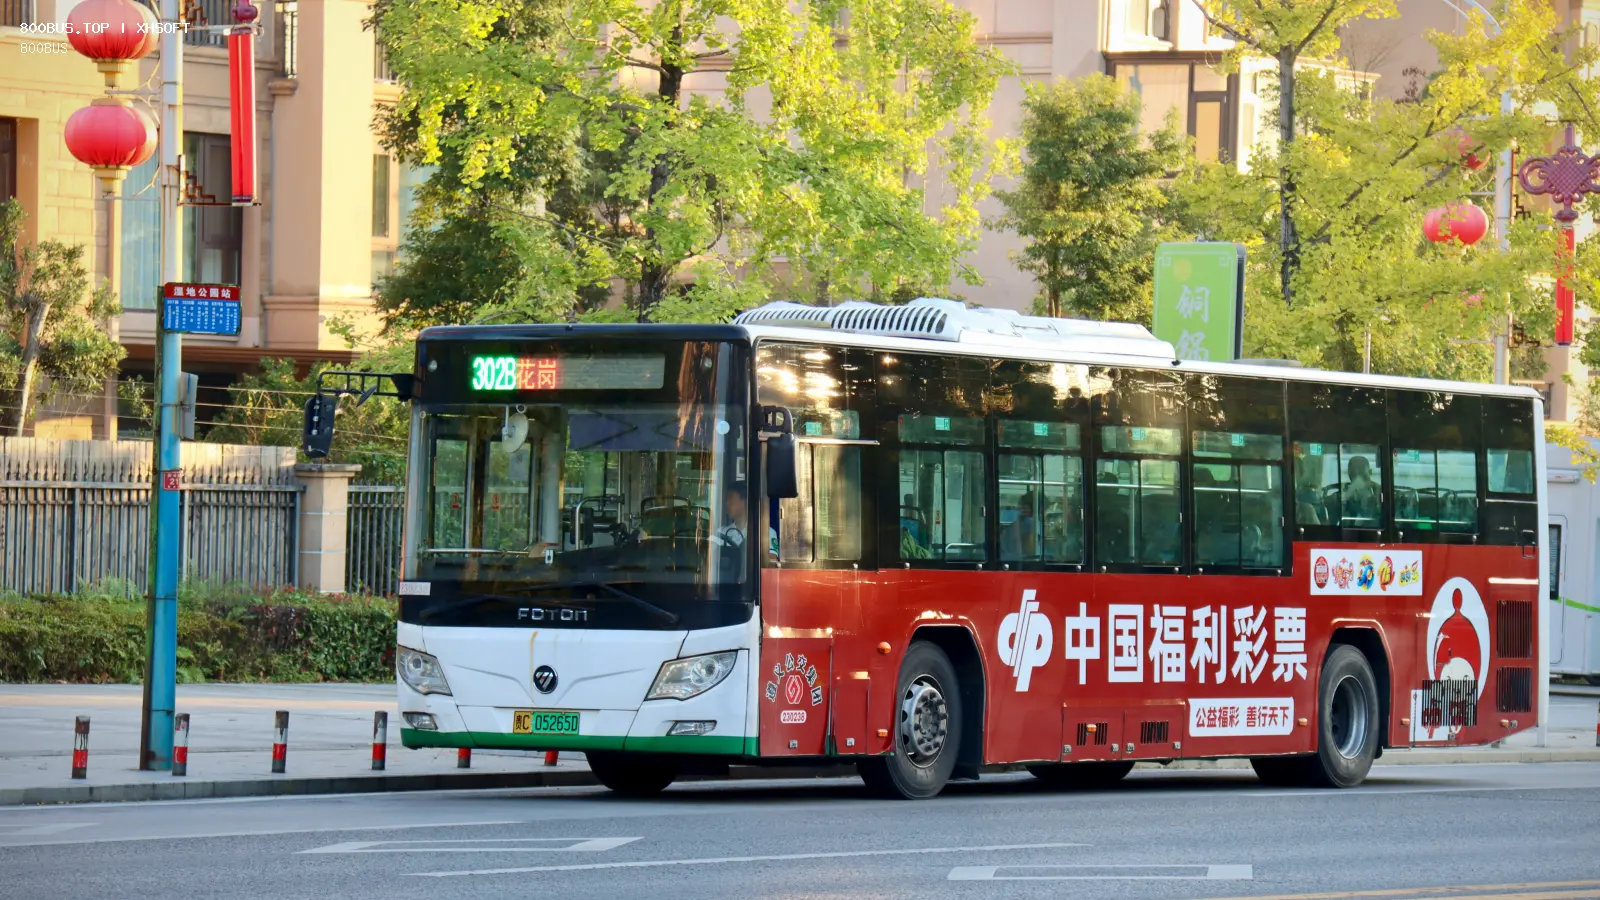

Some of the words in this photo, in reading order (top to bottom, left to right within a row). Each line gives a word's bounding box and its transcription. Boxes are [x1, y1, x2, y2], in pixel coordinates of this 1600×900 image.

[472, 357, 516, 390] 302B
[516, 357, 557, 390] 花岗
[517, 607, 588, 621] FOTON
[1065, 602, 1308, 685] 中国福利彩票
[1195, 706, 1240, 729] 公益福彩
[1246, 706, 1290, 728] 善行天下
